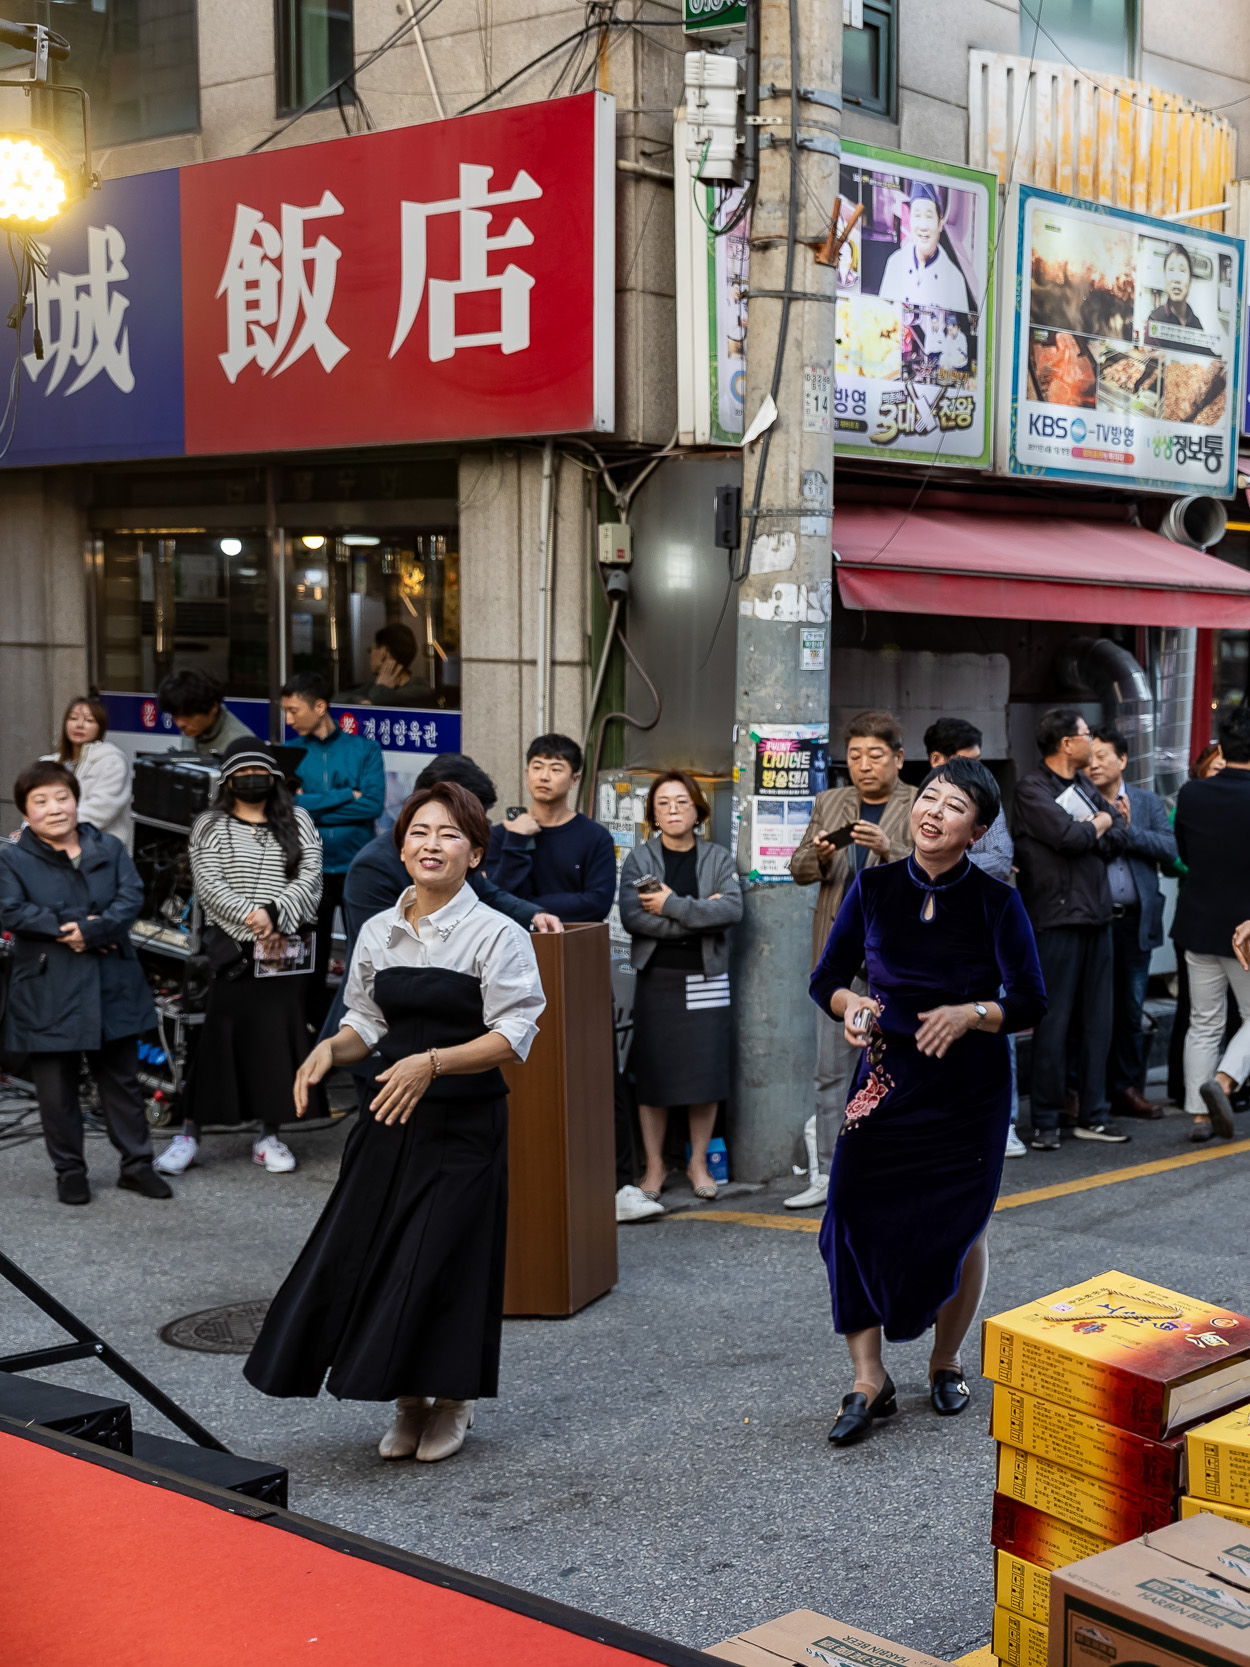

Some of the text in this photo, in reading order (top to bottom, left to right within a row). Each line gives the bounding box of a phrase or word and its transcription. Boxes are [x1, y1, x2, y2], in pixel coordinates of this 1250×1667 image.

[834, 386, 866, 416] 방영
[1028, 413, 1068, 439] KBS
[1137, 1591, 1225, 1630] HARBIN BEER
[842, 1635, 911, 1664] HARBIN BEER
